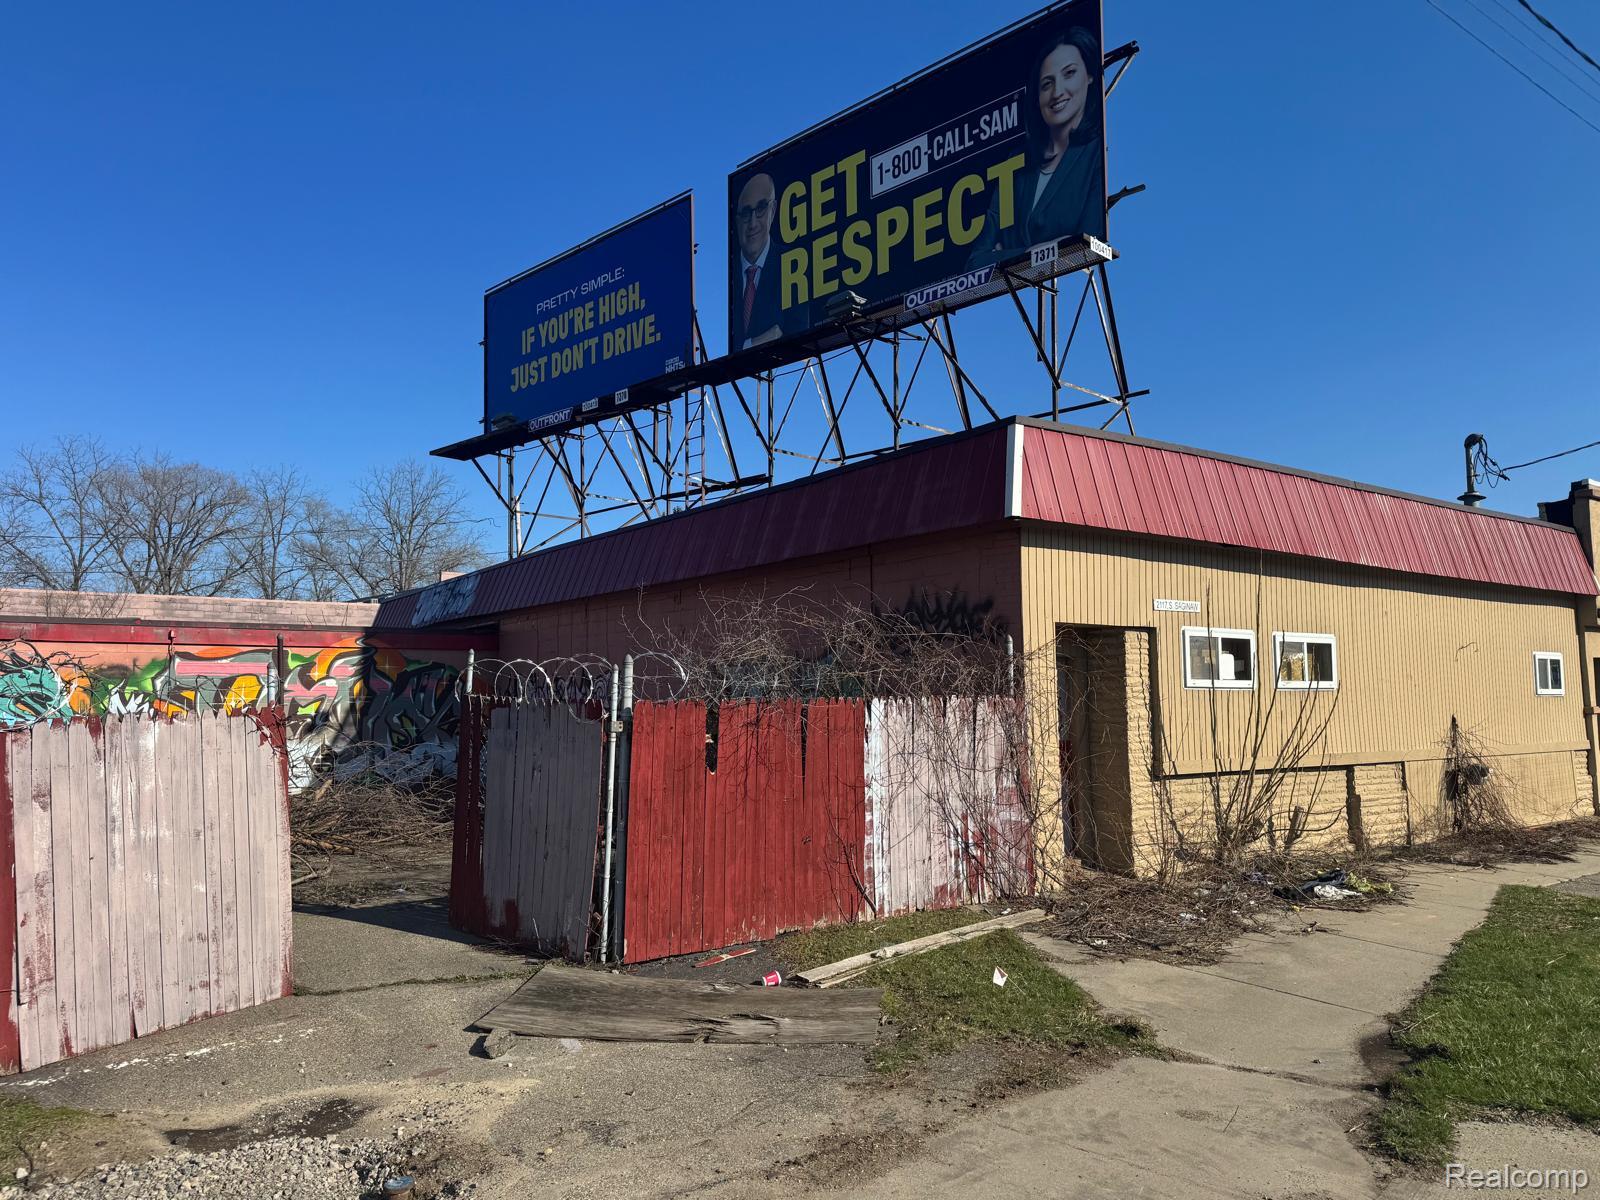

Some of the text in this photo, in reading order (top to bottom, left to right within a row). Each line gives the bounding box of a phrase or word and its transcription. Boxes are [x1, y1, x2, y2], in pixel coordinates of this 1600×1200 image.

[779, 149, 866, 244] GET
[780, 152, 1026, 311] RESPECT
[1034, 245, 1055, 263] 7371
[521, 281, 646, 355] IF YOU'RE HIGH,
[536, 267, 625, 315] PRETTY SIMPLE:
[906, 268, 990, 308] OUTFRONT
[510, 314, 662, 393] JUST DON'T DRIVE.
[530, 409, 571, 430] OUTFRONT
